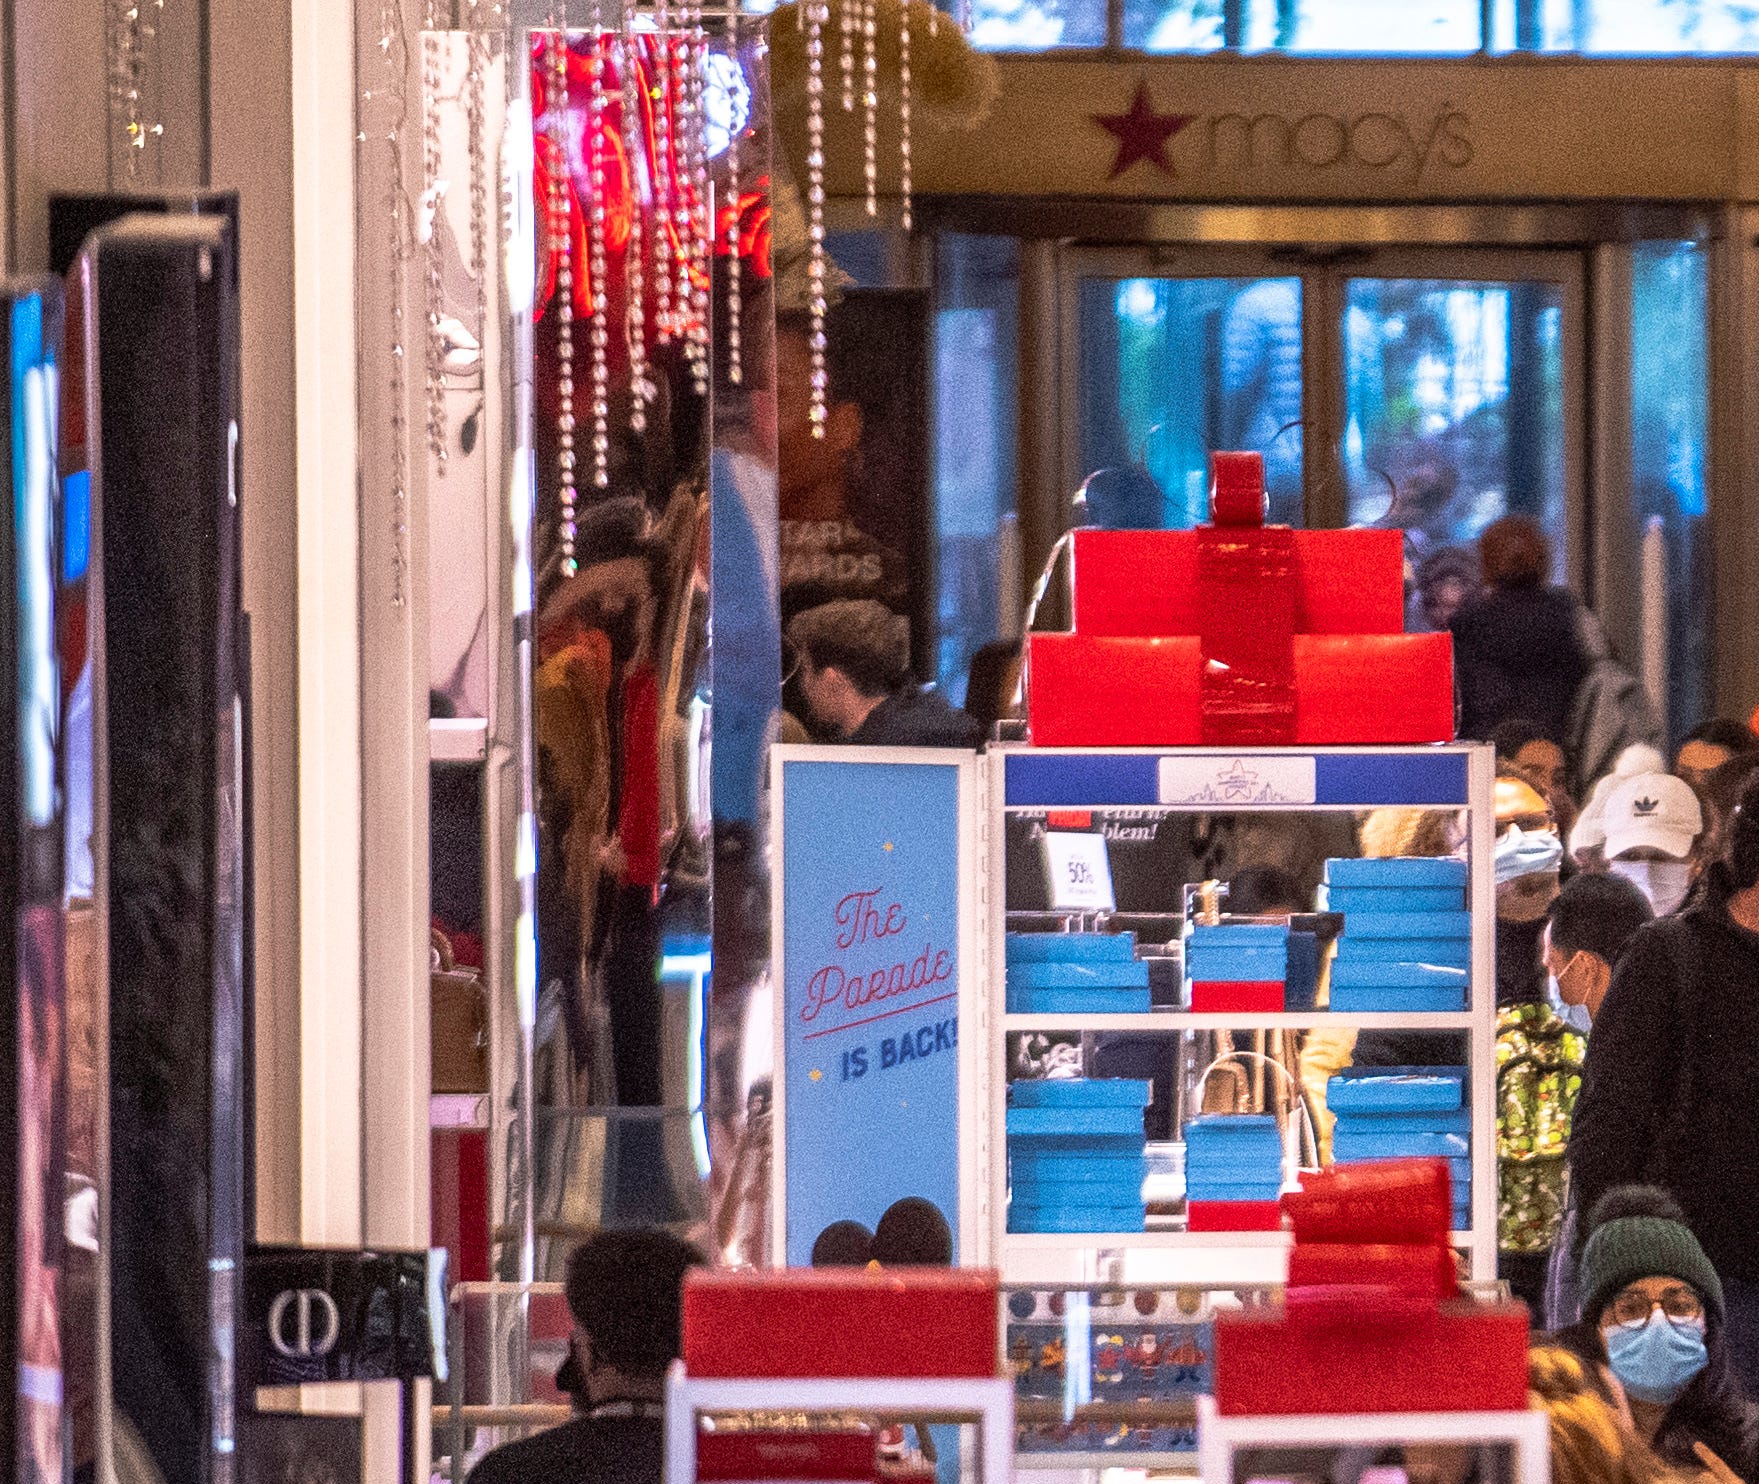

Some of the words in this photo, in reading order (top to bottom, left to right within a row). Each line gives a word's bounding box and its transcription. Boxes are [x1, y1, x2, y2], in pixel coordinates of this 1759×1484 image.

[1206, 100, 1473, 186] macy's
[834, 886, 907, 950] The
[800, 943, 954, 1022] Parade
[840, 1046, 871, 1082] IS
[880, 1016, 959, 1071] BACK!
